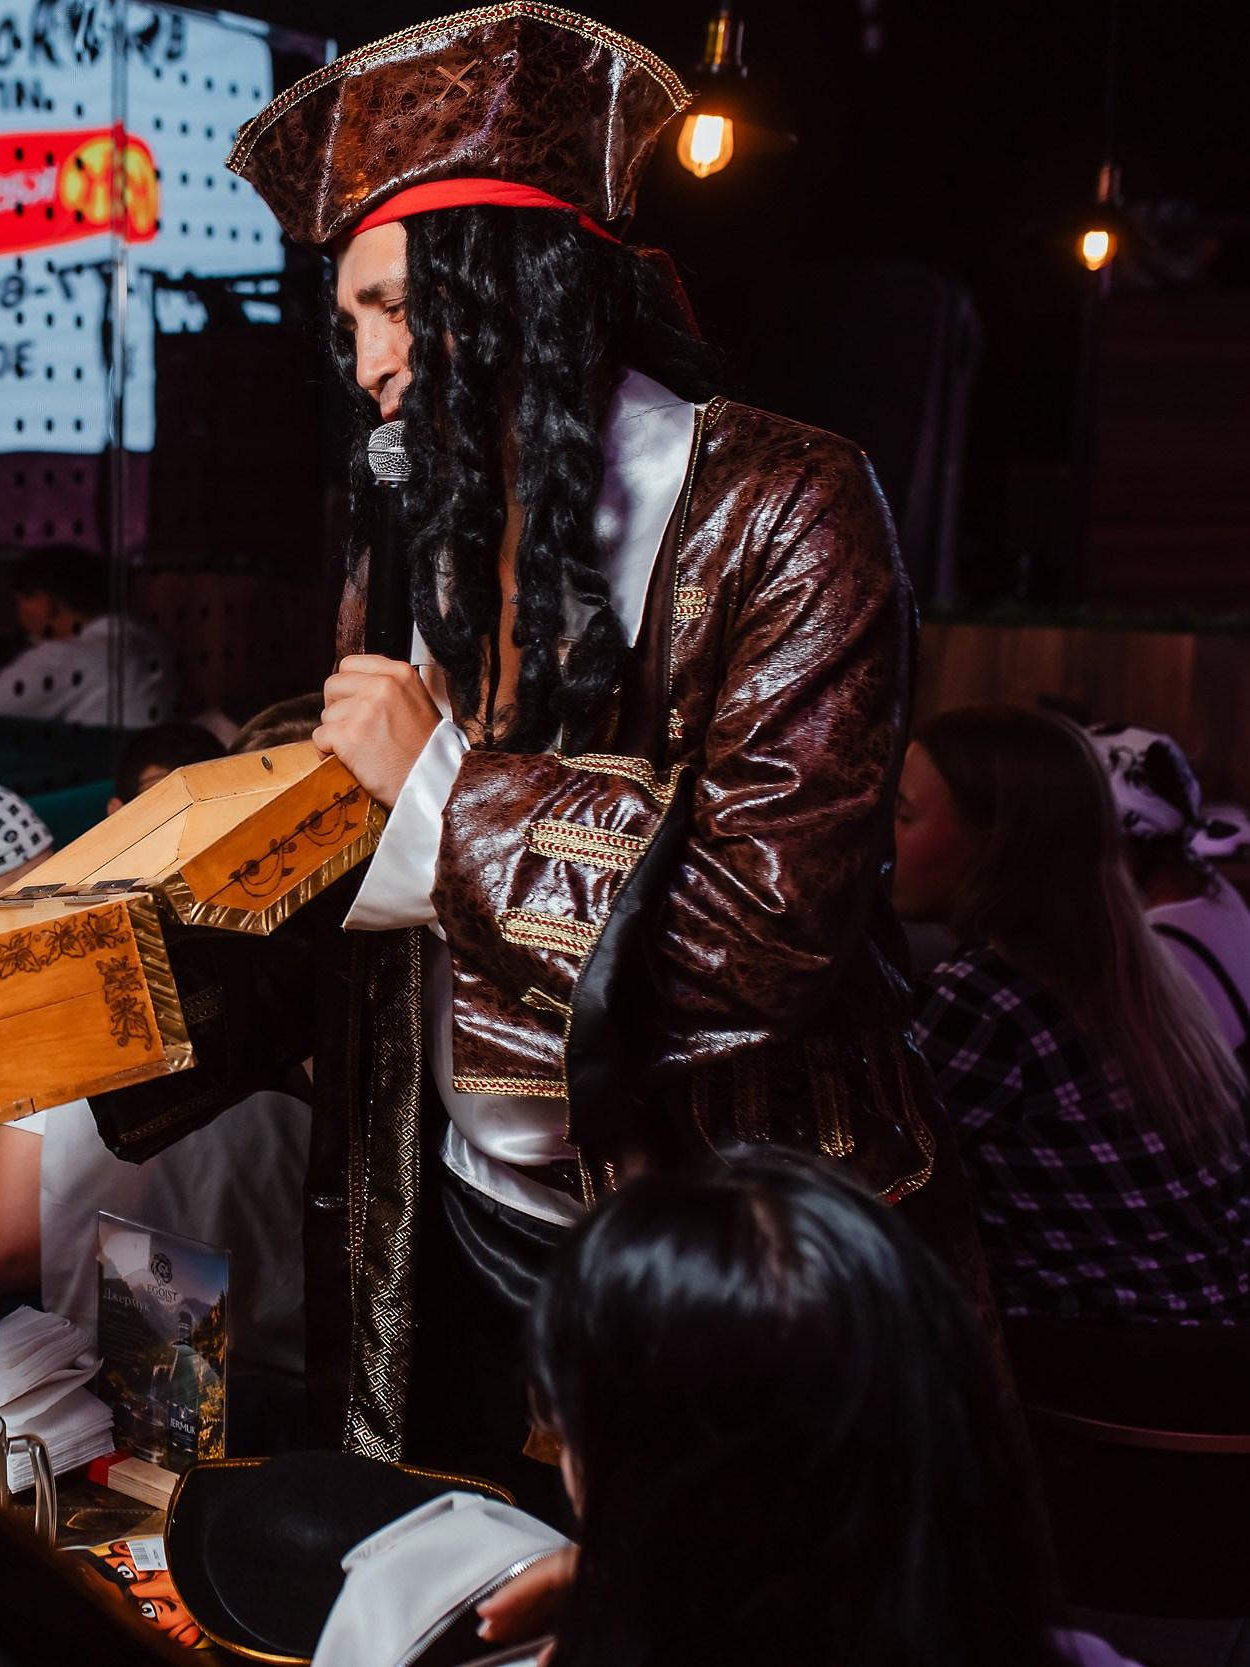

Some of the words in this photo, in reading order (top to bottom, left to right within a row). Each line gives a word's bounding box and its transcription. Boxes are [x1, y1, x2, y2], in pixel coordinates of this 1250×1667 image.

[102, 1286, 151, 1313] Джермук
[146, 1283, 179, 1302] EGOIST
[169, 1417, 197, 1435] JERMUK
